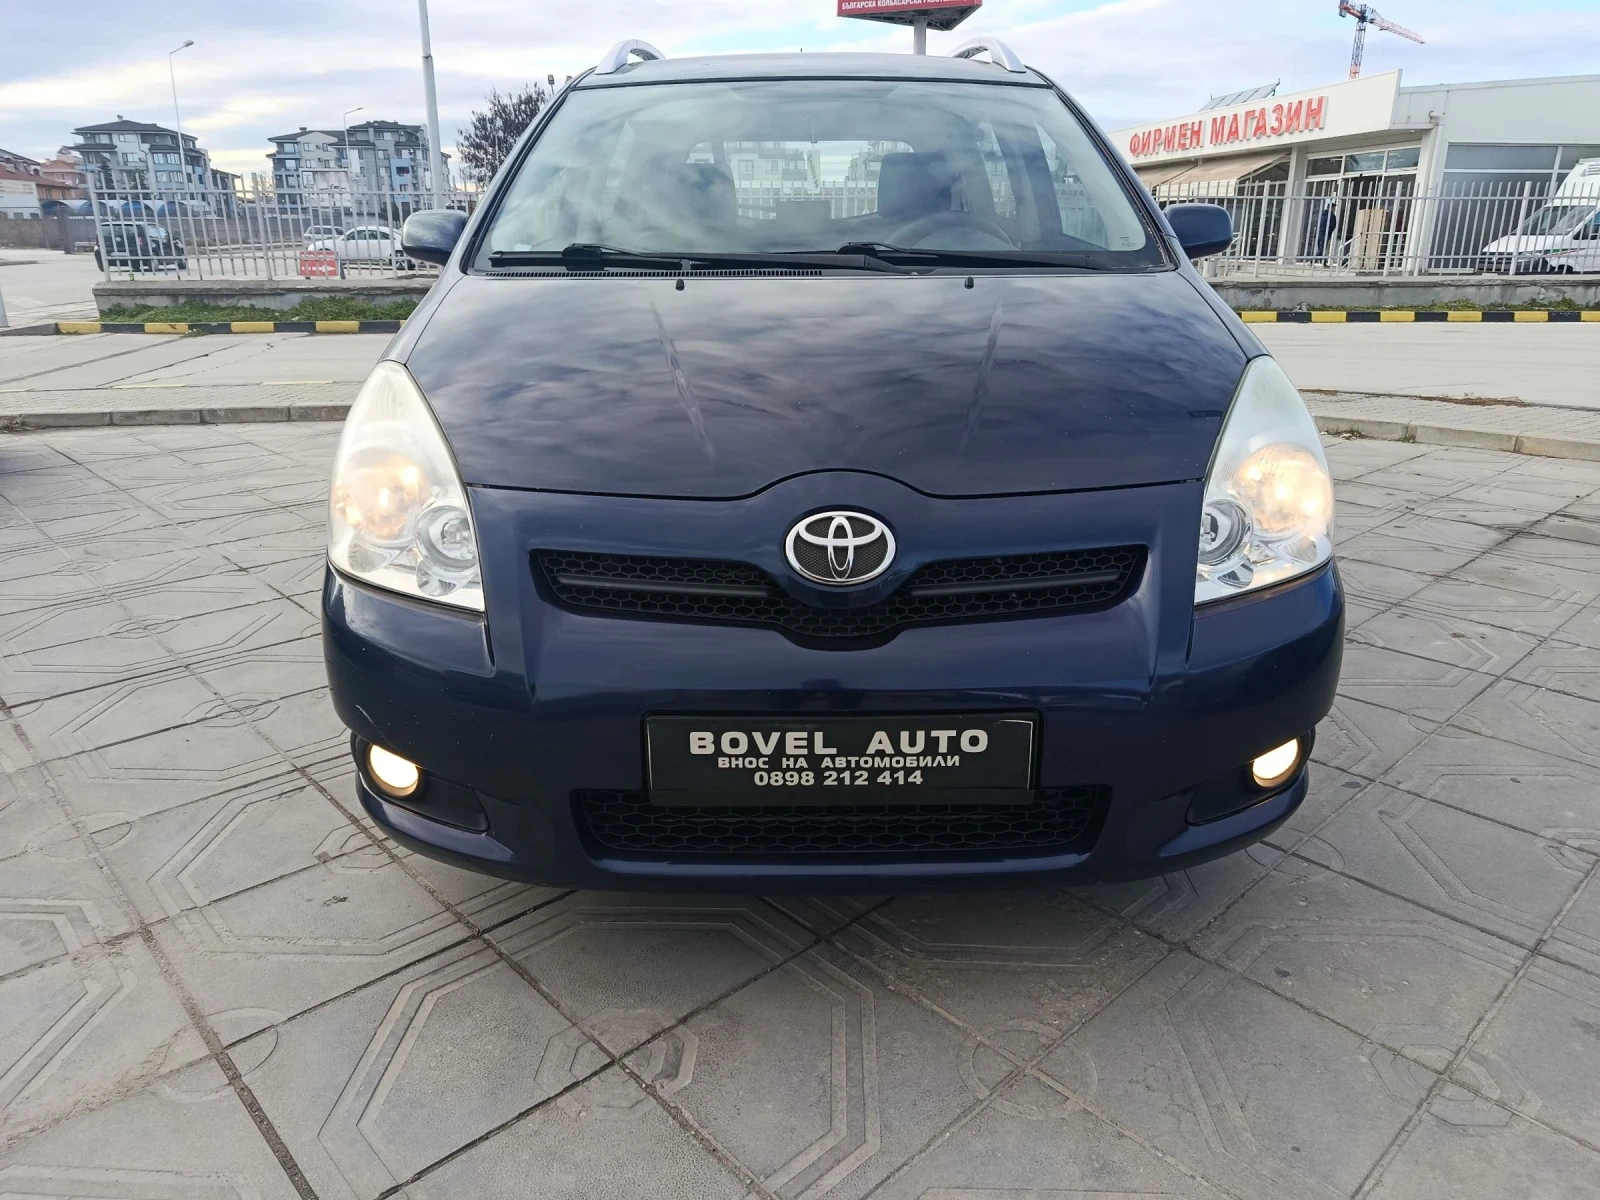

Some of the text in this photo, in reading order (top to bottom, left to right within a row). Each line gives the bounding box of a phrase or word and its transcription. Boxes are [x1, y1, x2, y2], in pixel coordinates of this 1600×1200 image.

[842, 1, 876, 10] БЪЛГАРСКА
[1129, 96, 1326, 156] ФИРМЕН МАГАЗИН
[689, 729, 988, 755] BOVEL AUTO
[717, 755, 960, 769] ВНОС НА АВТОМОБИЛИ
[753, 770, 923, 786] 0898 212 414
